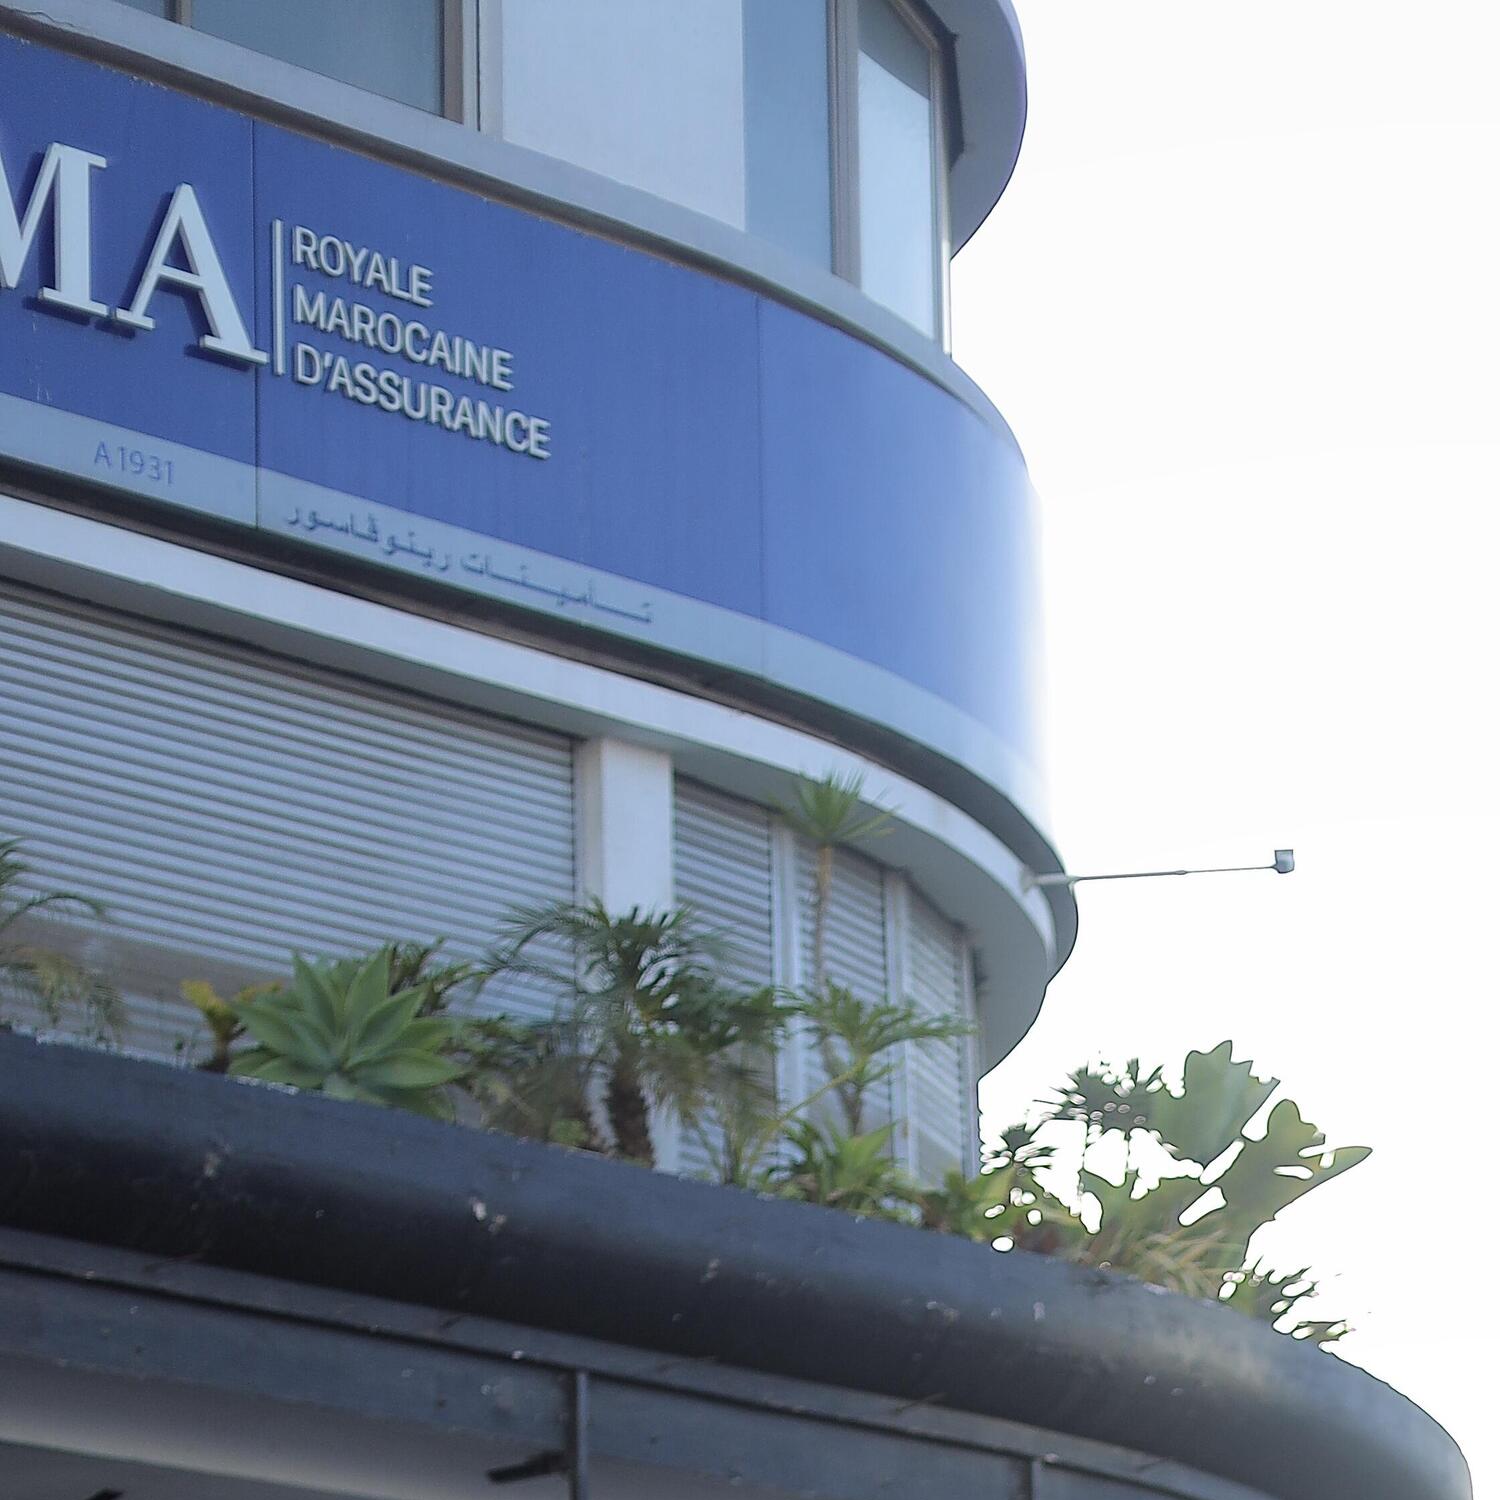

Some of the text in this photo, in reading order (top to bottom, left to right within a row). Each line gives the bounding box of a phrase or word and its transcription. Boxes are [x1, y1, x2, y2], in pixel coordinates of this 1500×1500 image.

[292, 225, 434, 308] ROYALE
[293, 284, 514, 392] MAROCAINE
[294, 342, 551, 460] D'ASSURANCE
